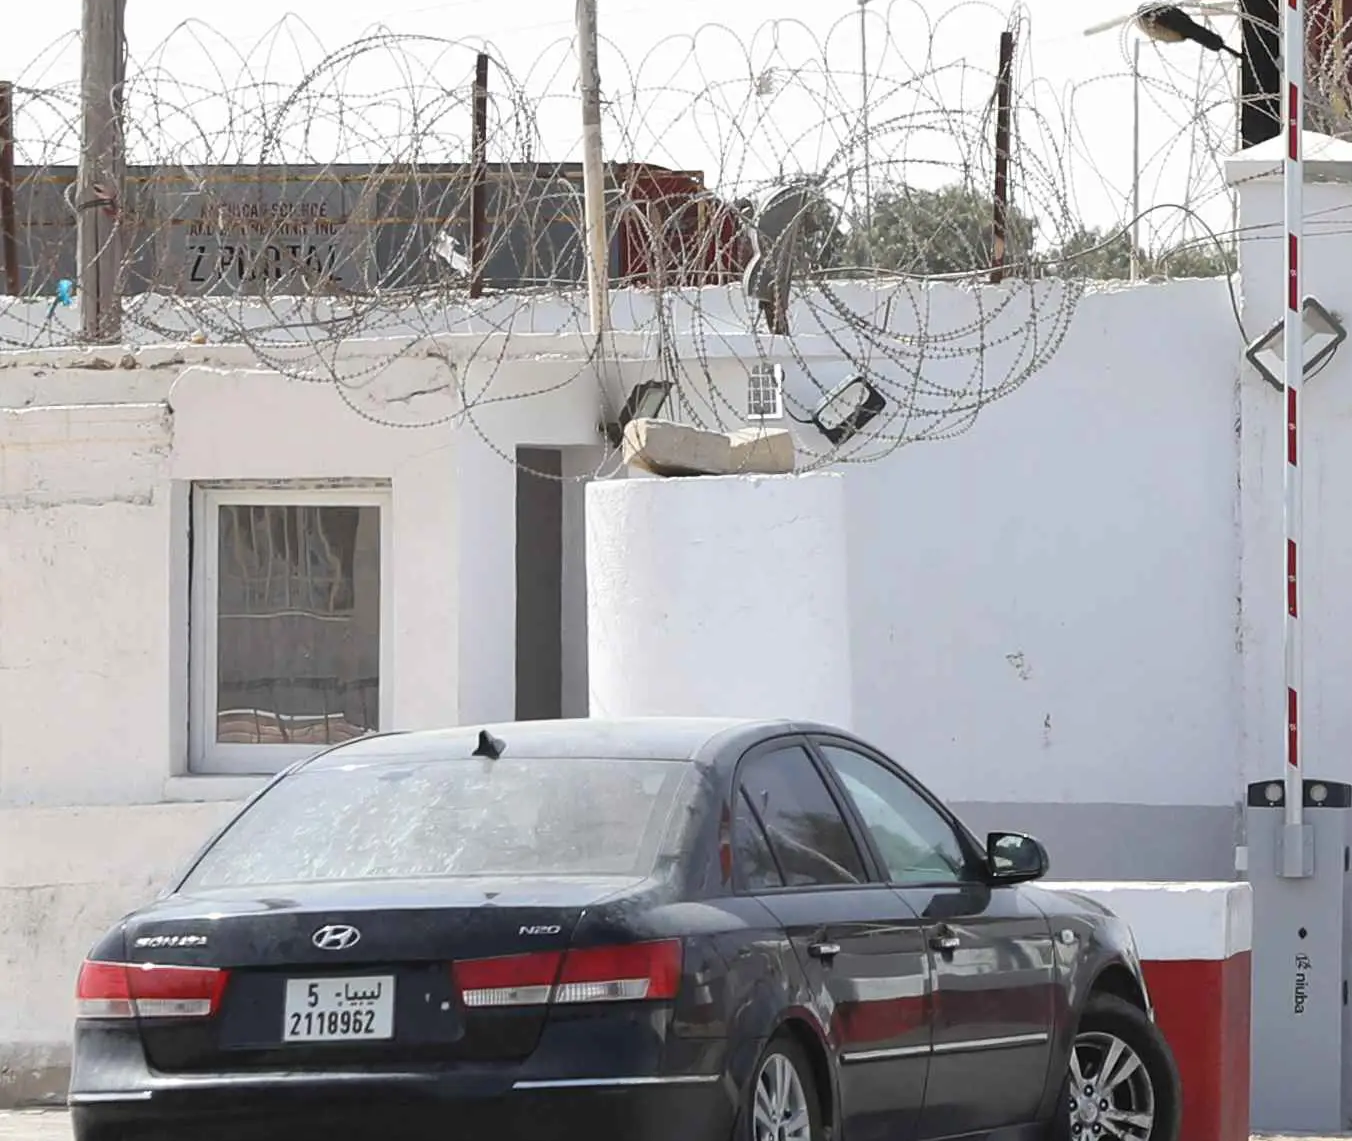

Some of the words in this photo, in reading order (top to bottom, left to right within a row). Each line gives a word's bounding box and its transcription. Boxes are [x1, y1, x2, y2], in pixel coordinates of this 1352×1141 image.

[189, 245, 206, 281] Z
[307, 983, 319, 1008] 5
[1295, 972, 1308, 1014] niuba
[290, 1009, 375, 1036] 2118962
